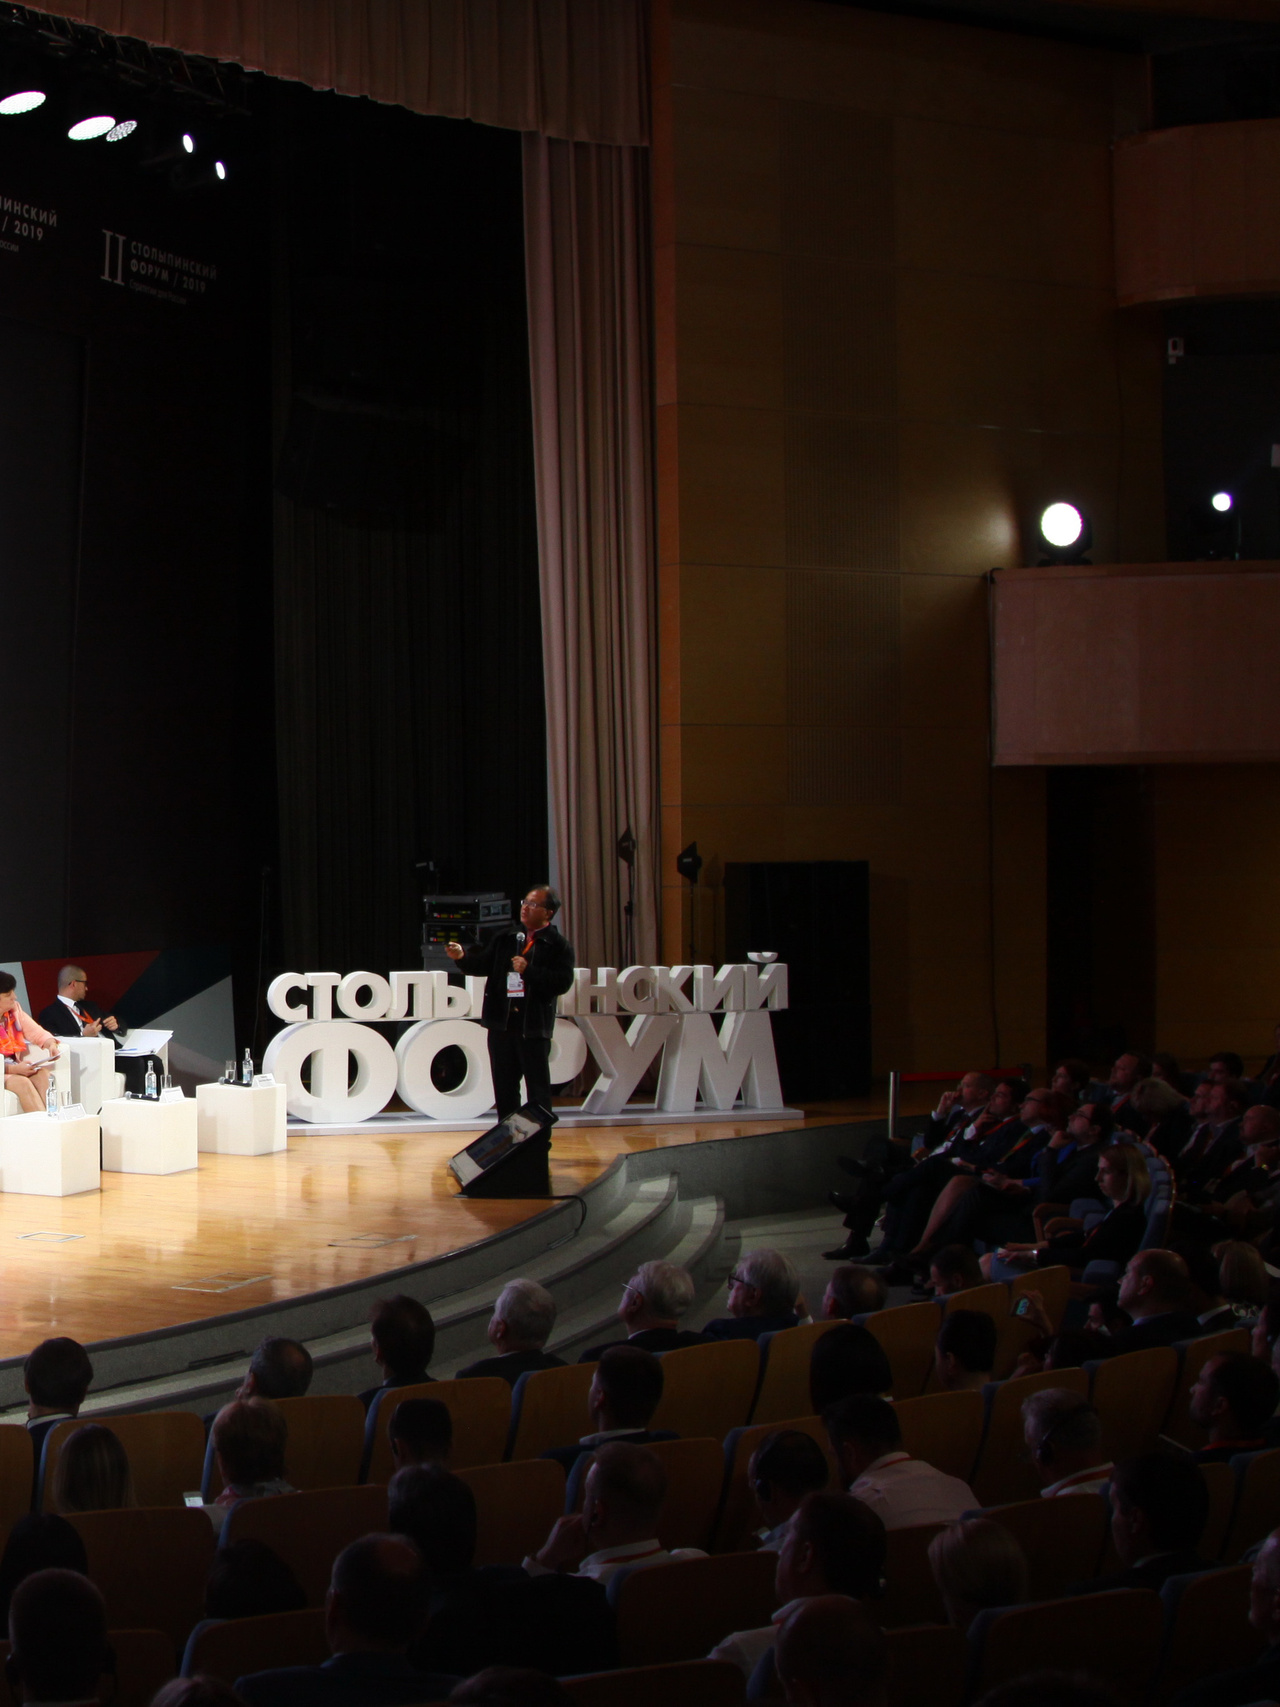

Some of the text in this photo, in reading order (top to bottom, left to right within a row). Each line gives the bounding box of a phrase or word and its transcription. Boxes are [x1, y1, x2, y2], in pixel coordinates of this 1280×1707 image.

[1, 215, 9, 232] /
[13, 219, 45, 241] 2019
[100, 228, 127, 287] II
[129, 257, 170, 283] ФОРУМ
[182, 275, 207, 294] 2019
[130, 240, 218, 281] СТОЛЫПИНСКИЙ
[267, 951, 789, 1021] СТОЛЫНСКИЙ
